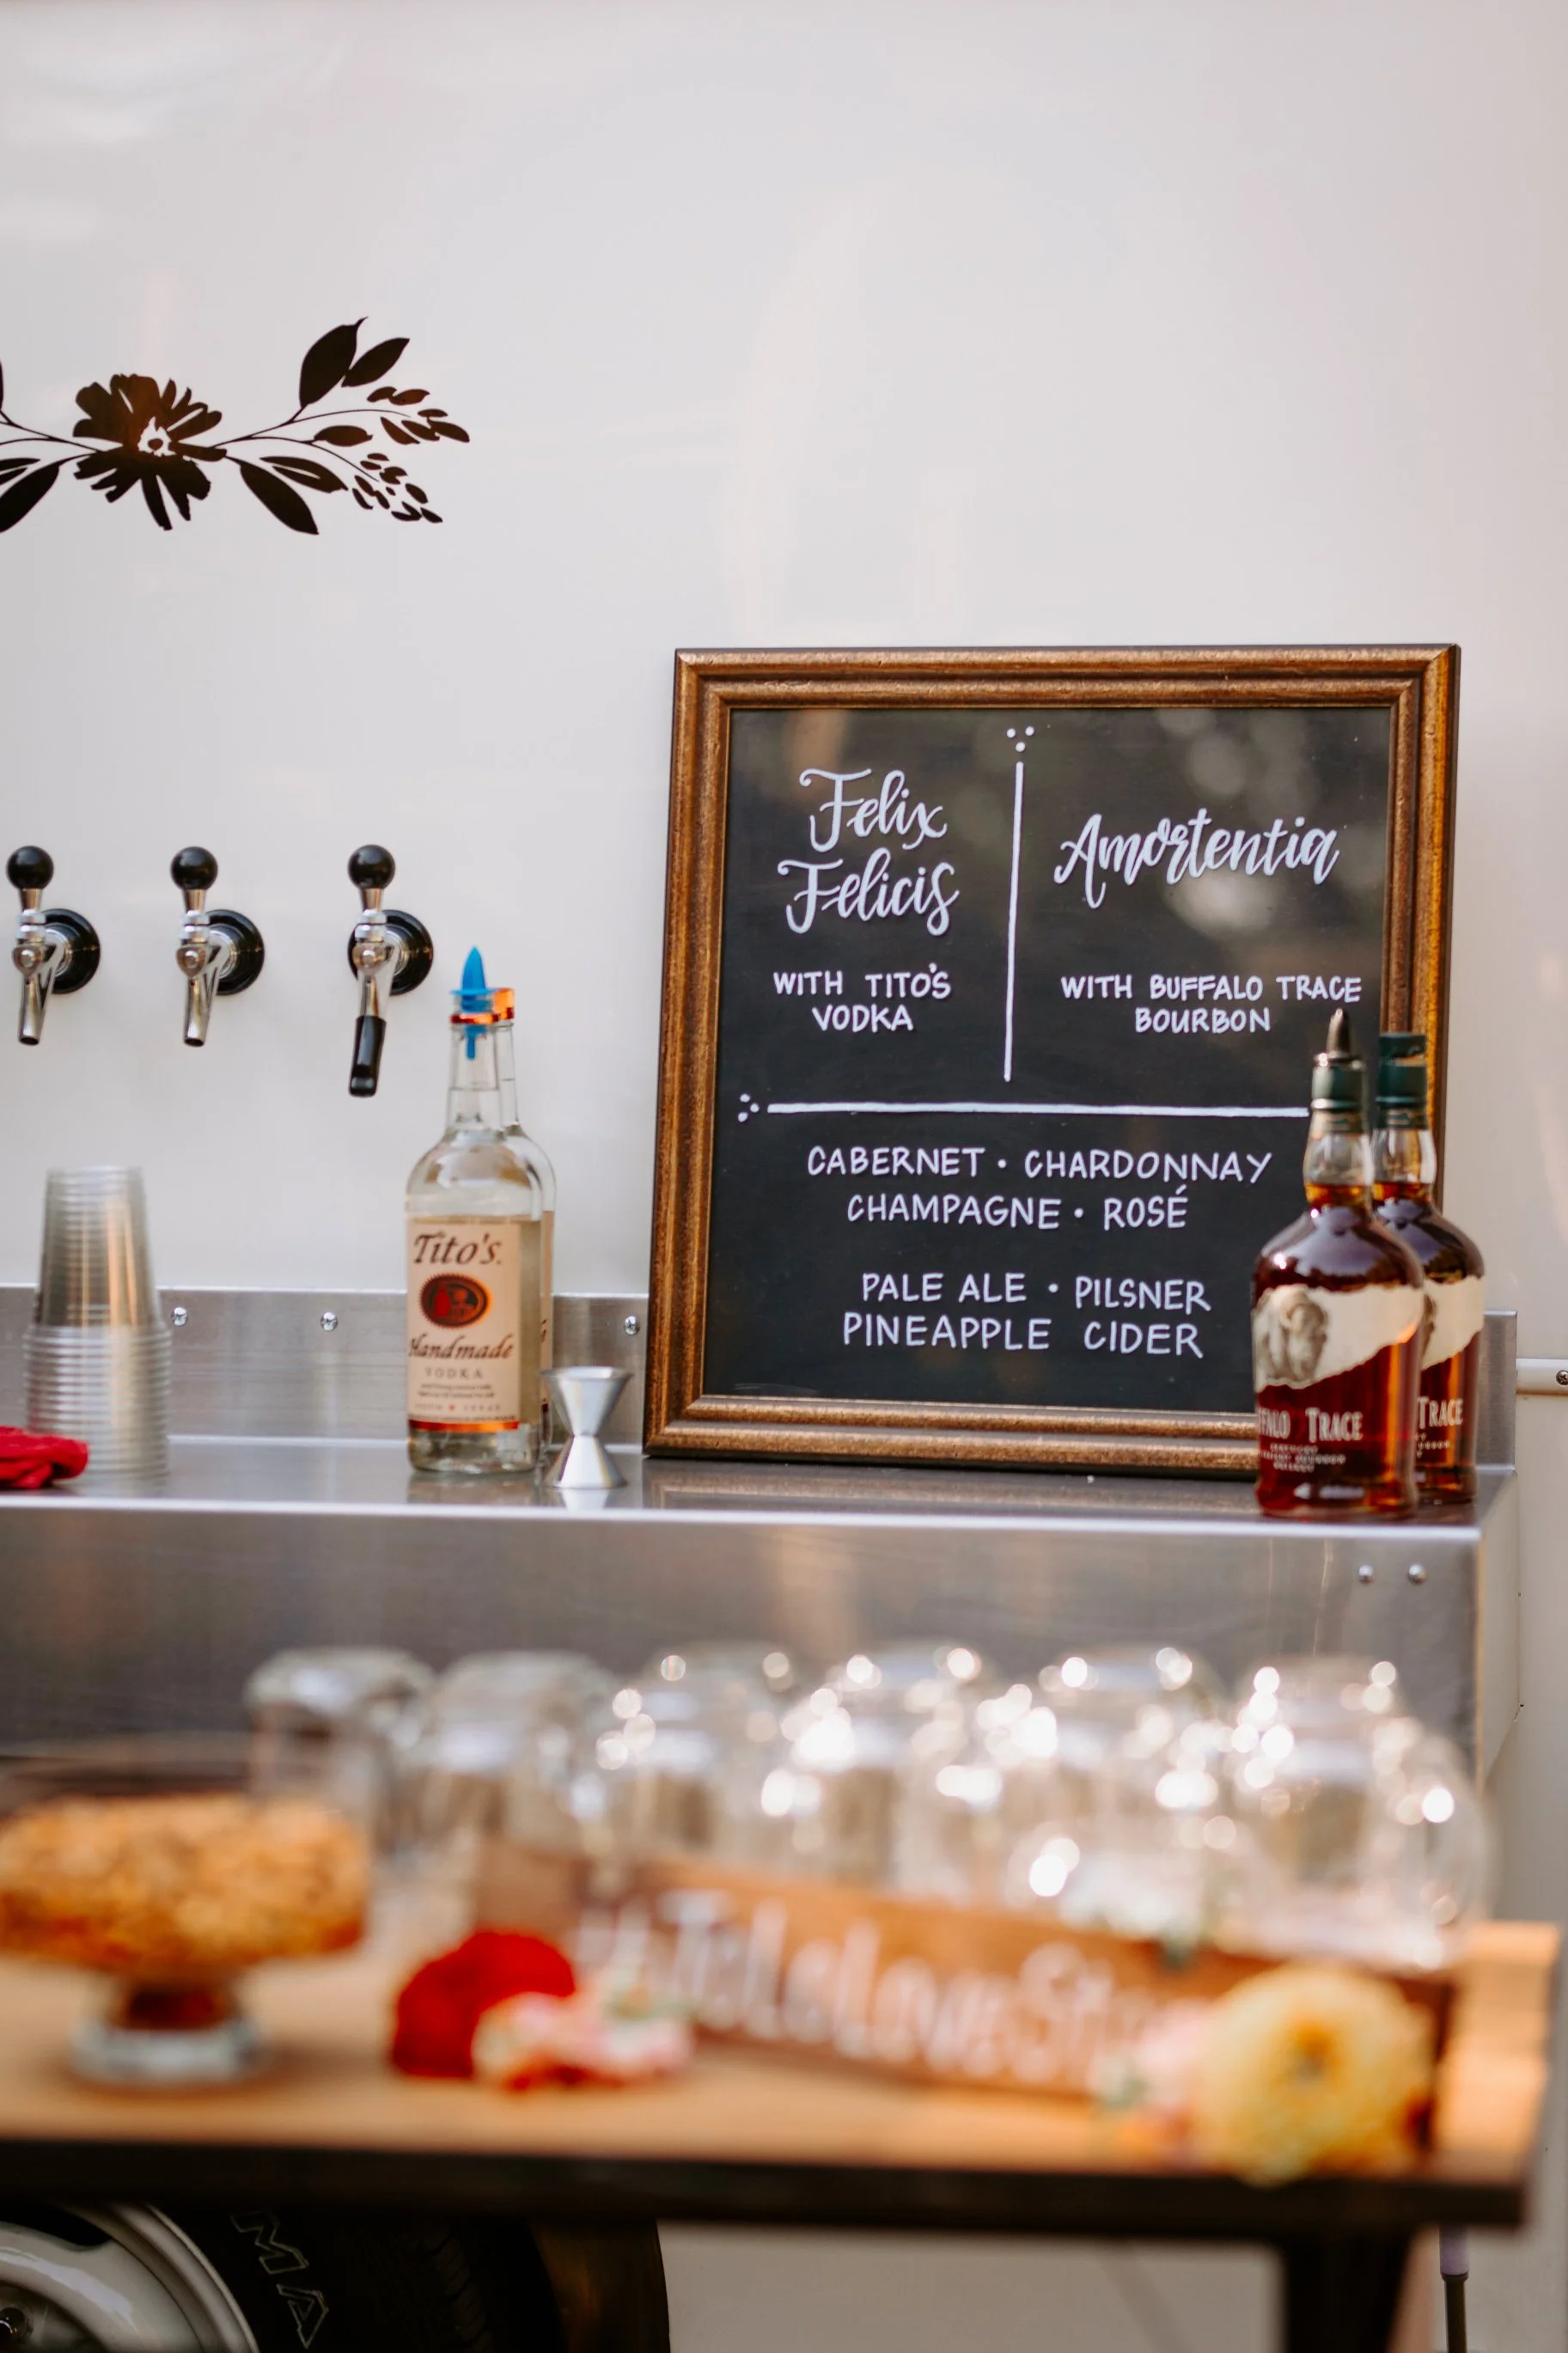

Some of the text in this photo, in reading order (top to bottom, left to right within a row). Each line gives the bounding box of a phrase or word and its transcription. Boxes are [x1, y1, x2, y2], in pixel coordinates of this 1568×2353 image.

[799, 768, 948, 853] Felix
[1053, 808, 1340, 909] Amortentia
[777, 847, 960, 936] Felicis
[773, 962, 952, 999] WITH TITO'S
[1060, 974, 1363, 1003] WITH BUFFALO TRACE
[812, 1003, 914, 1034] VODKA
[1135, 1006, 1272, 1033] BOURBON
[807, 1146, 1272, 1183] CABERNET CHARDONNAY
[846, 1183, 1189, 1231] CHAMPAGNE ROSÉ
[862, 1273, 1212, 1315] PALE ALE PILSNER
[407, 1333, 515, 1360] Handmade
[843, 1311, 1204, 1359] PINEAPPLE CIDER
[424, 1366, 483, 1379] VODKA
